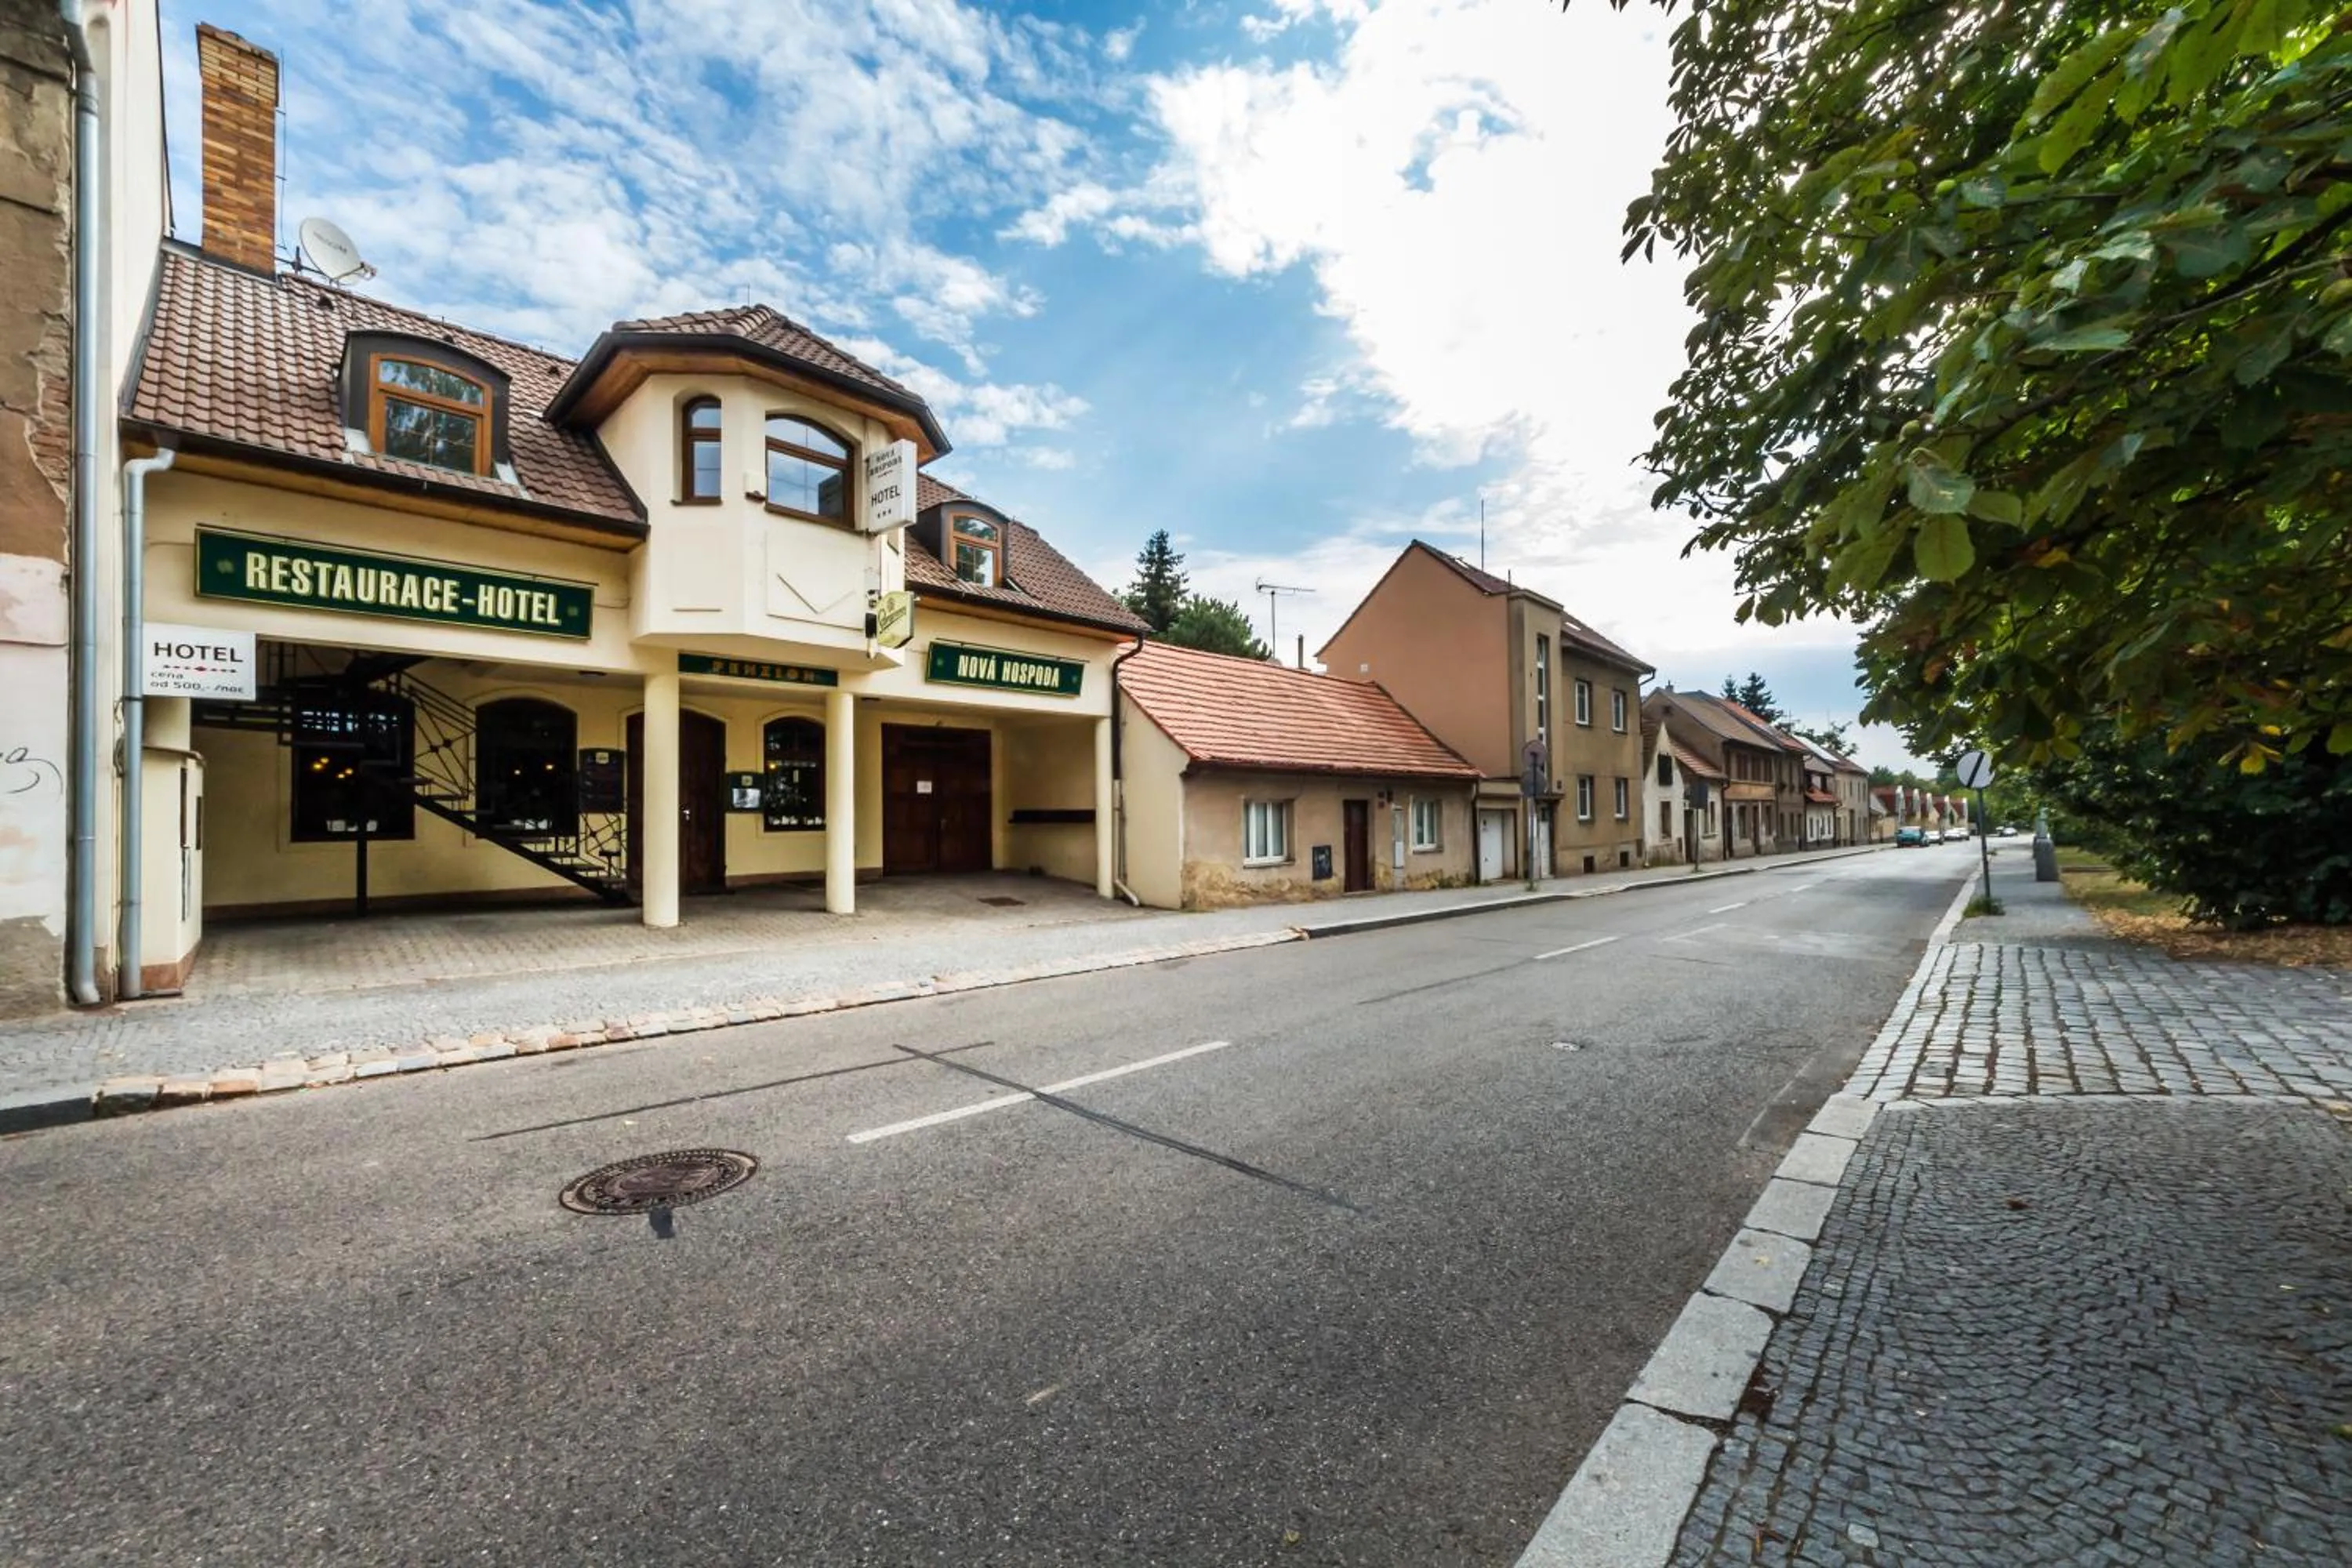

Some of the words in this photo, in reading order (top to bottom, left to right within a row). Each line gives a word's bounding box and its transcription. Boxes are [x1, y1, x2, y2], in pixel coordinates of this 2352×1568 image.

[871, 485, 900, 506] HOTEL
[154, 642, 244, 662] HOTEL
[151, 670, 184, 680] cena
[957, 655, 996, 681] NOVÁ
[1001, 660, 1060, 688] HOSPODA
